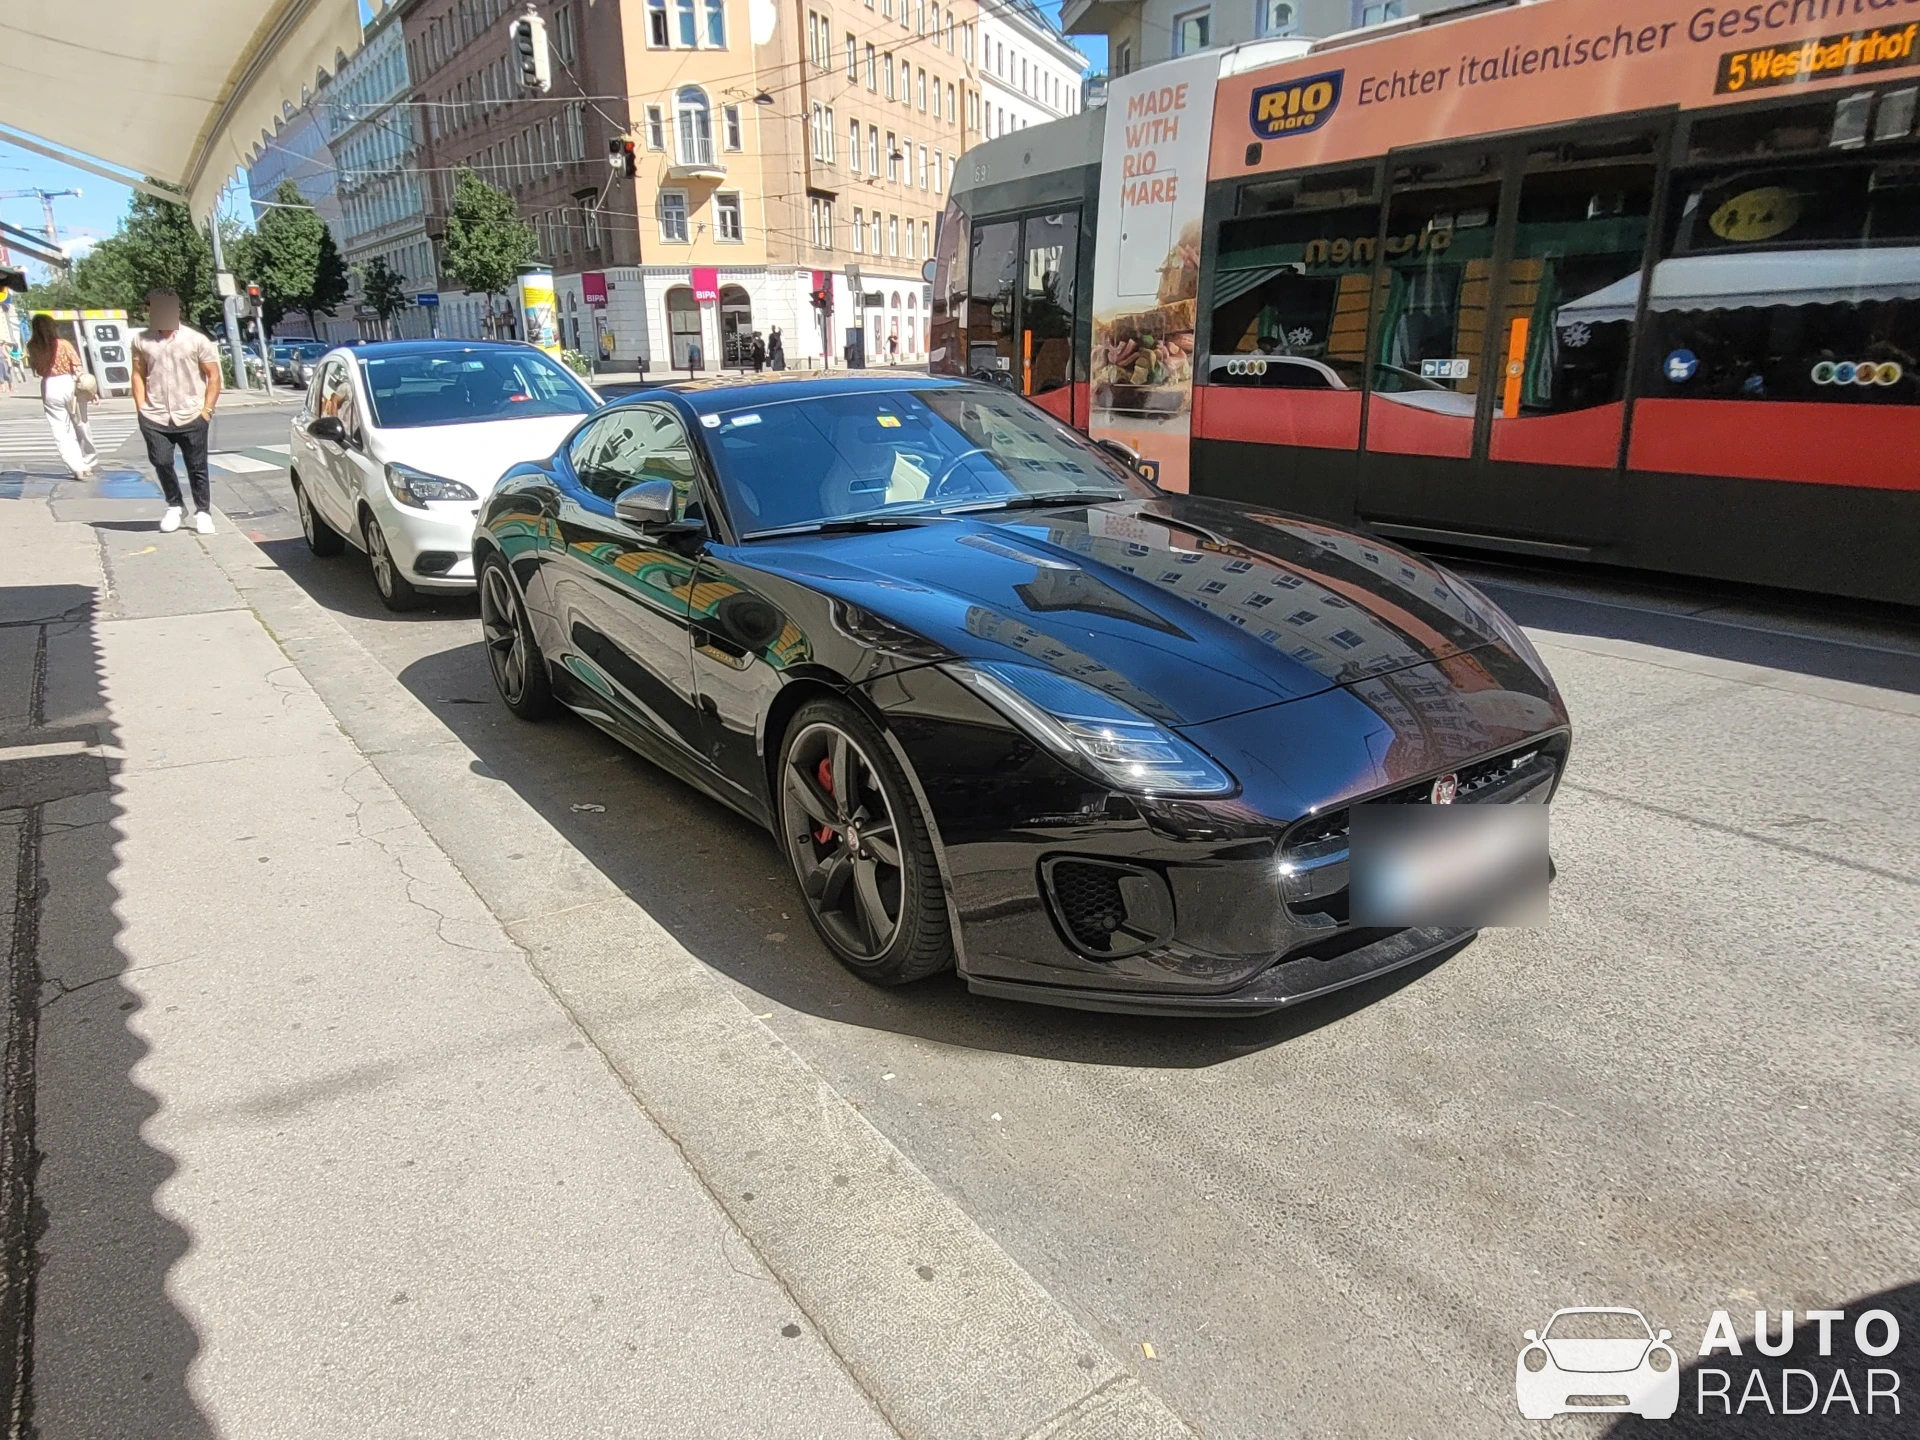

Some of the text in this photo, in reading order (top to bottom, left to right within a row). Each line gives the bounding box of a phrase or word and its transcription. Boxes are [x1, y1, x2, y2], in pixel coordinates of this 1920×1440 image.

[1358, 0, 1920, 106] Echter italienischer Geschm
[1727, 23, 1918, 91] 5 Westbahnhof
[1127, 82, 1188, 120] MADE
[1257, 81, 1333, 121] RIO
[1125, 115, 1179, 149] WITH
[1267, 113, 1315, 133] mare
[1122, 150, 1157, 179] RIO
[1120, 176, 1178, 208] MARE
[586, 294, 606, 302] BIPA
[695, 290, 717, 299] BIPA
